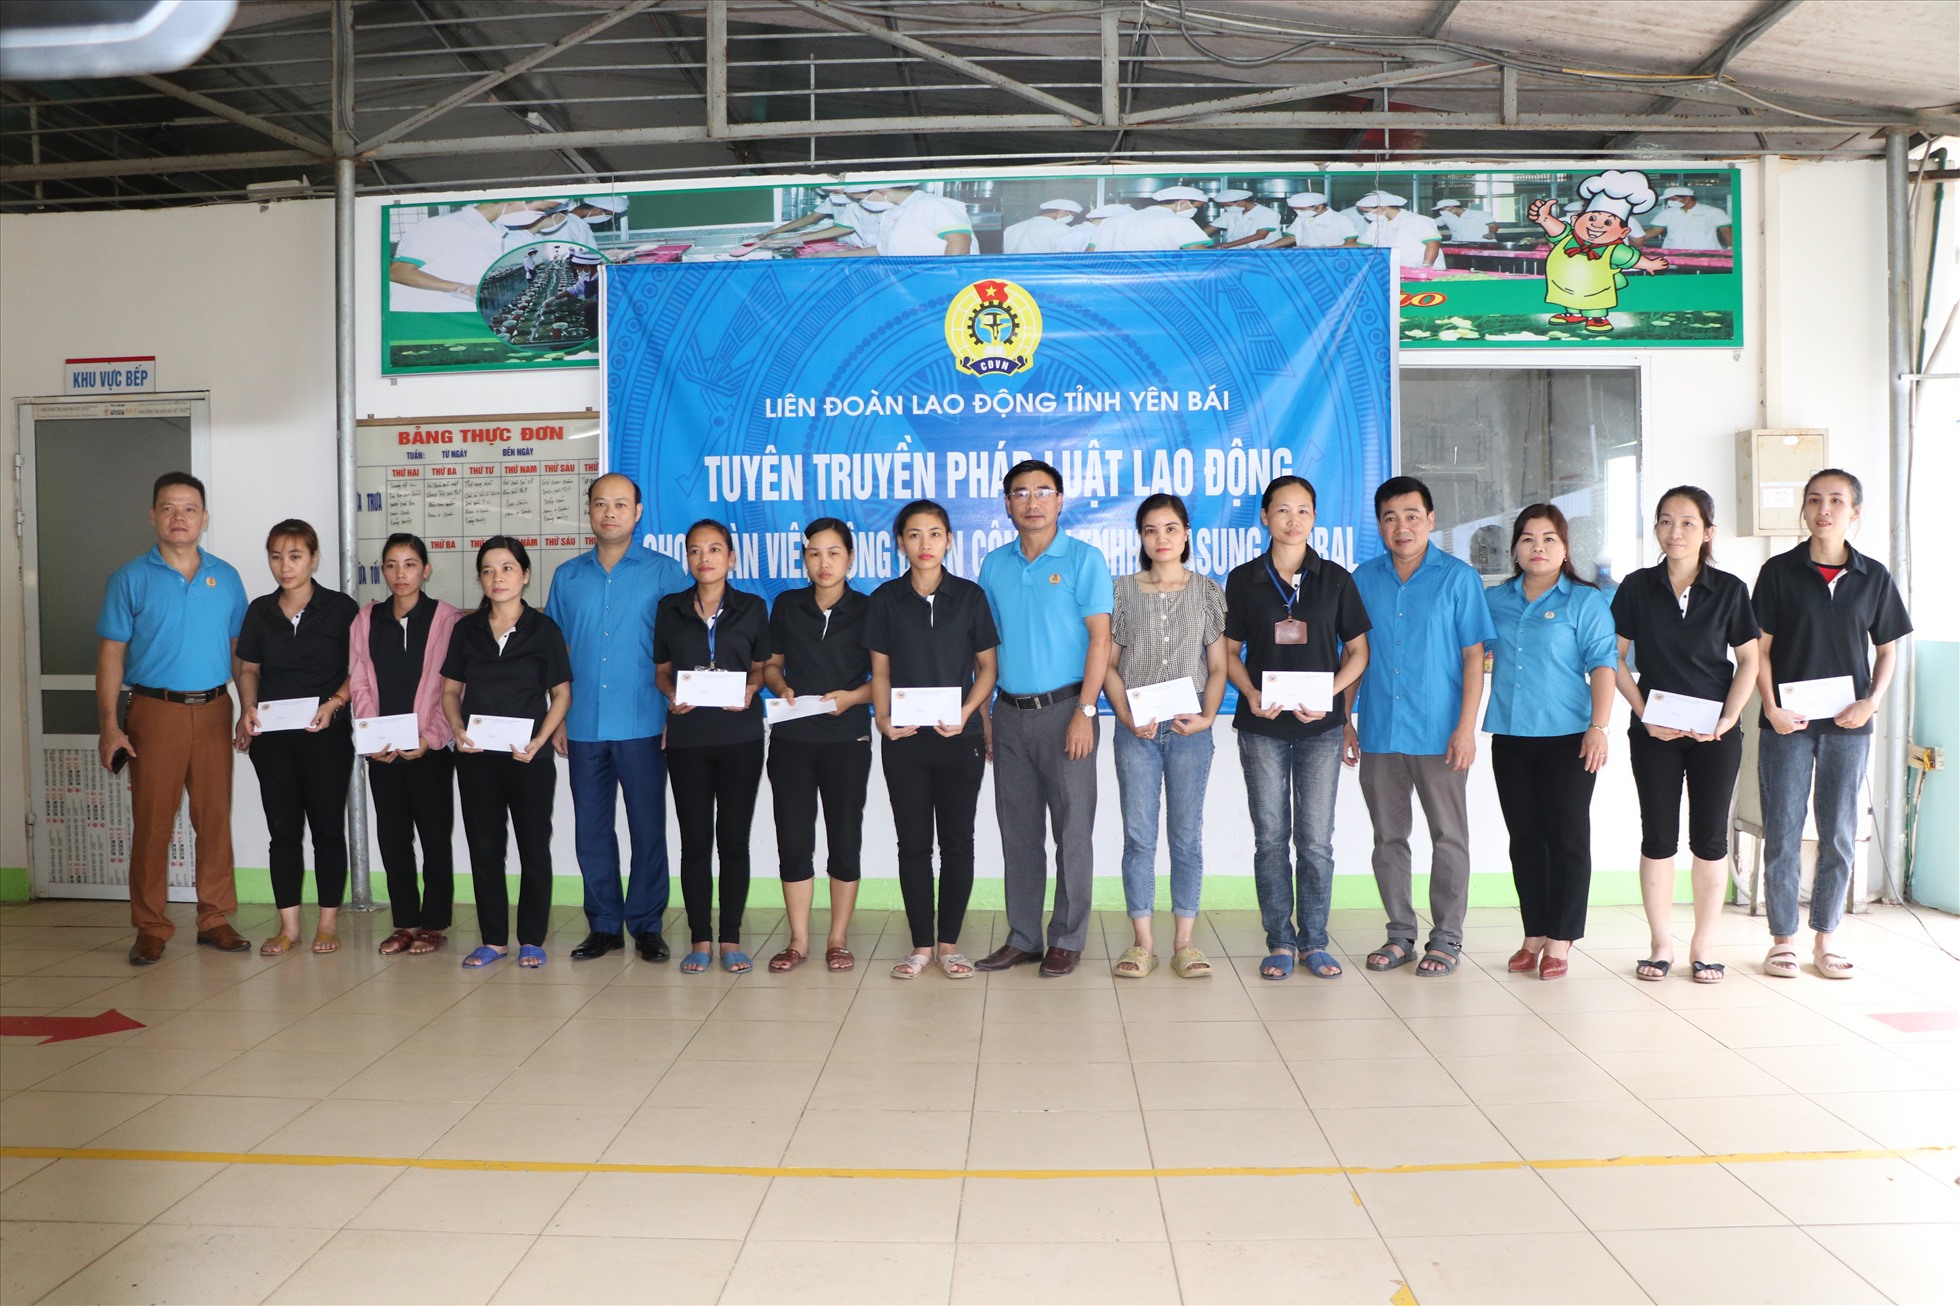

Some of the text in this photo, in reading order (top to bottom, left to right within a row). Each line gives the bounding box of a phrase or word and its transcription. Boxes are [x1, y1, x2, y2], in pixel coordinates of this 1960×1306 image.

[980, 360, 1009, 371] CĐVN
[73, 364, 148, 391] KHU VỰC BẾP
[765, 384, 1230, 418] LIÊN ĐOÀN LAO ĐỘNG TỈNH YÊN BÁI
[398, 425, 564, 445] BẢNG THỰC ĐƠN
[451, 448, 468, 458] NGÀY
[502, 446, 534, 456] ĐẾN NGÀY
[392, 466, 420, 477] THỨ HAI
[431, 465, 457, 476] THỨ BA
[469, 464, 484, 475] THỨ
[504, 463, 519, 474] THỨ
[544, 462, 559, 473] THỨ
[704, 445, 803, 502] TUYÊN
[813, 435, 935, 500] TRUYỀN
[947, 440, 1032, 498] PHÁ
[1046, 439, 1123, 507] UẬT
[1133, 448, 1194, 497] LAO
[430, 538, 456, 549] THỨ BA
[544, 535, 559, 546] THỨ
[765, 522, 808, 579] VIÊ
